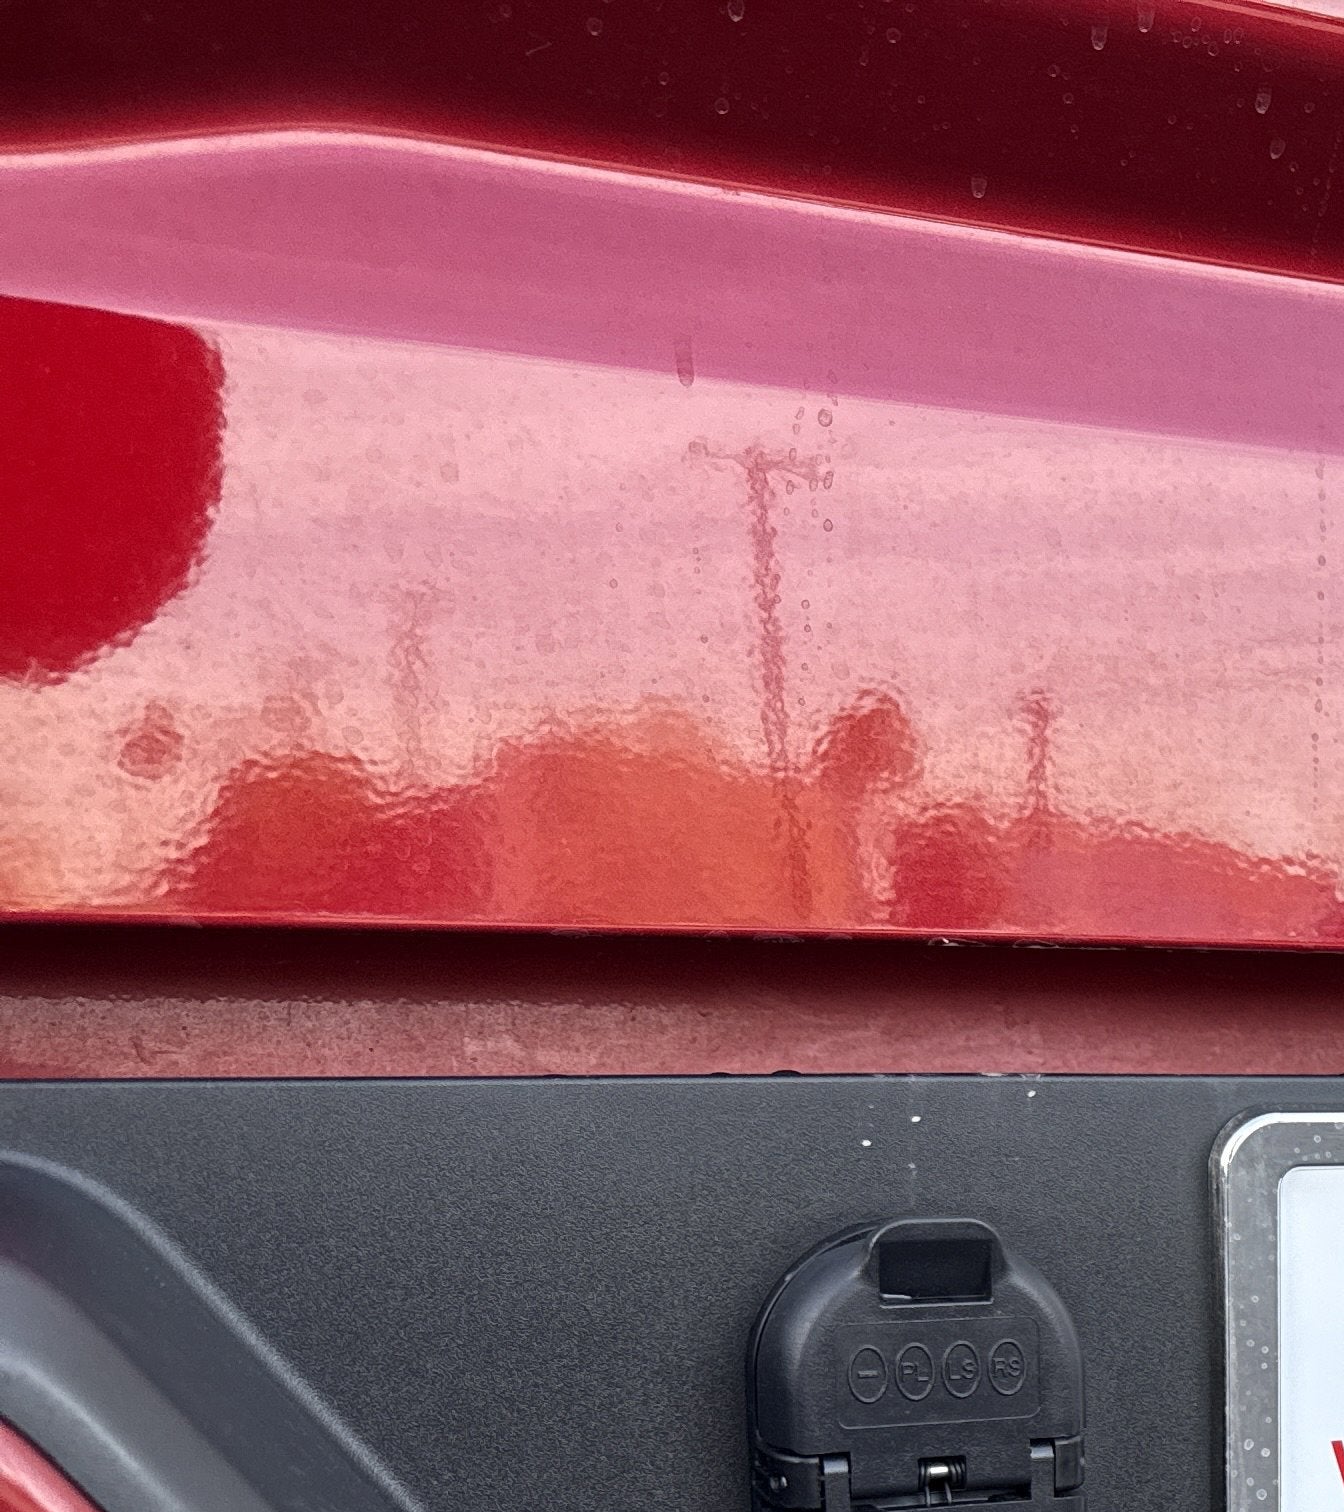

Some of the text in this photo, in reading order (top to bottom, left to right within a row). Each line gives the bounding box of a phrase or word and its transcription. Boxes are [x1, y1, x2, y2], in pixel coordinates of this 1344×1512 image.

[901, 1356, 1022, 1382] PL LS RS
